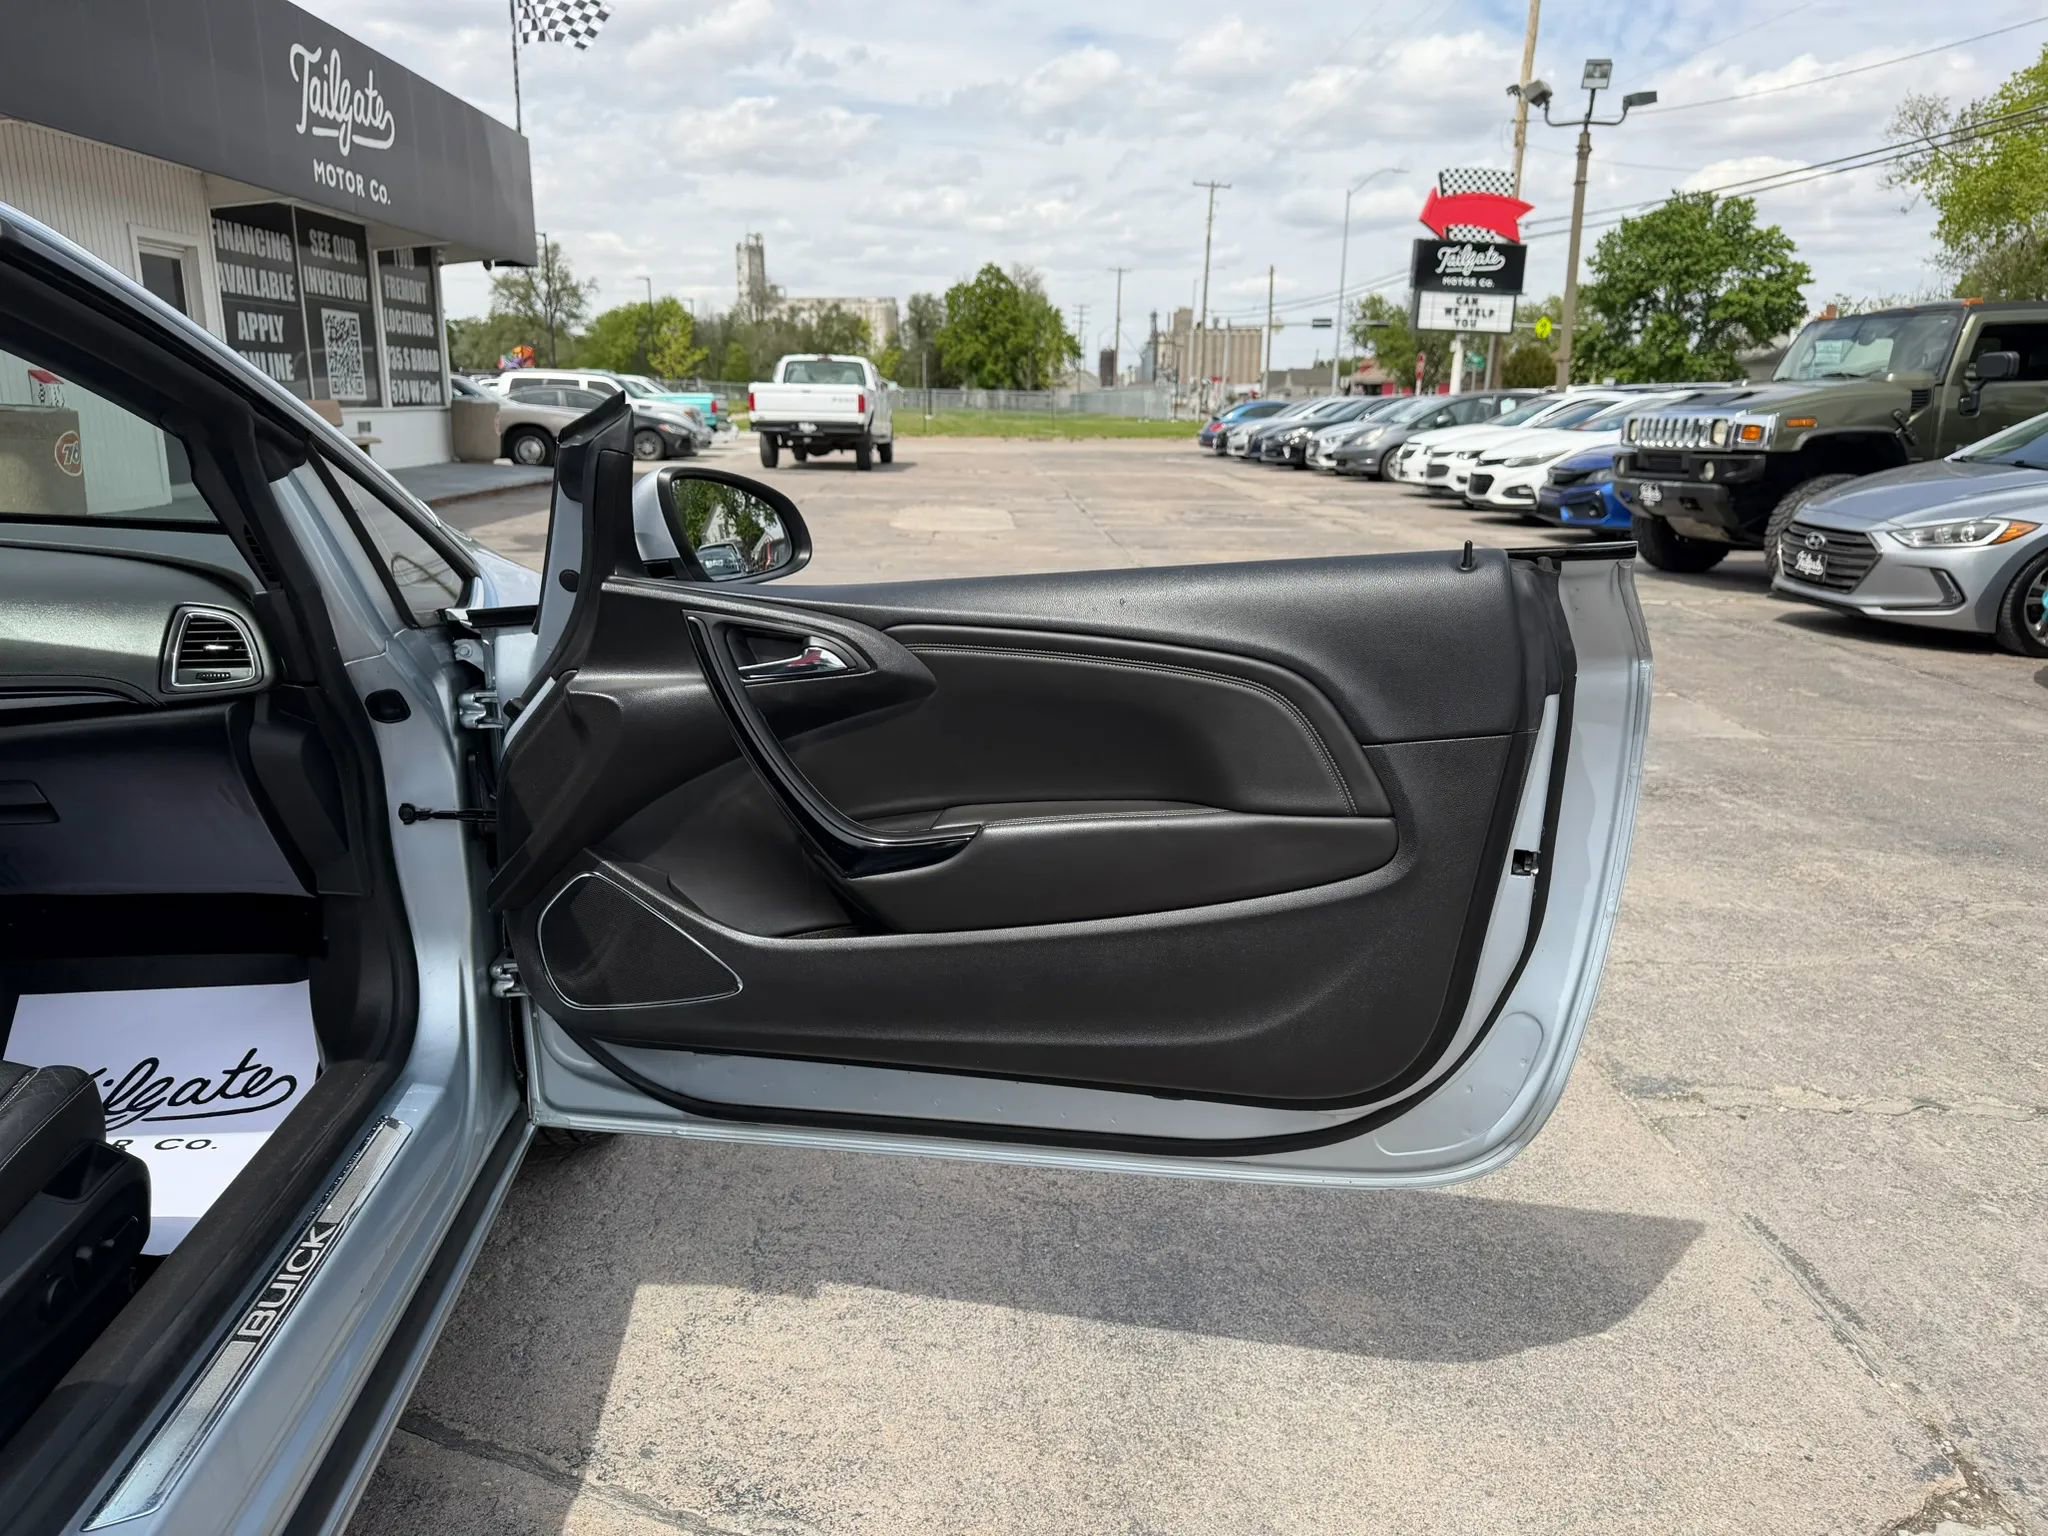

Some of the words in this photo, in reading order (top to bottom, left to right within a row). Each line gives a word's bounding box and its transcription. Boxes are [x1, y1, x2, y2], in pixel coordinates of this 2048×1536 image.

[290, 43, 395, 156] Tailgate
[313, 158, 365, 198] MOTOR
[370, 179, 391, 205] CO.
[309, 228, 332, 259] SEE
[333, 234, 358, 265] OUR
[1435, 243, 1506, 276] Tailgate
[217, 261, 296, 302] AVAILABLE
[303, 265, 368, 303] INVENTORY
[384, 274, 427, 305] FREMONT
[1442, 276, 1477, 287] MOTOR
[1445, 307, 1459, 316] WE
[1467, 308, 1495, 318] HELP
[1456, 297, 1479, 305] CAN
[237, 311, 284, 344] APPLY
[384, 307, 435, 337] LOCATIONS
[1454, 319, 1477, 328] YOU
[154, 1138, 218, 1151] CO.
[236, 1224, 337, 1337] BUICK
